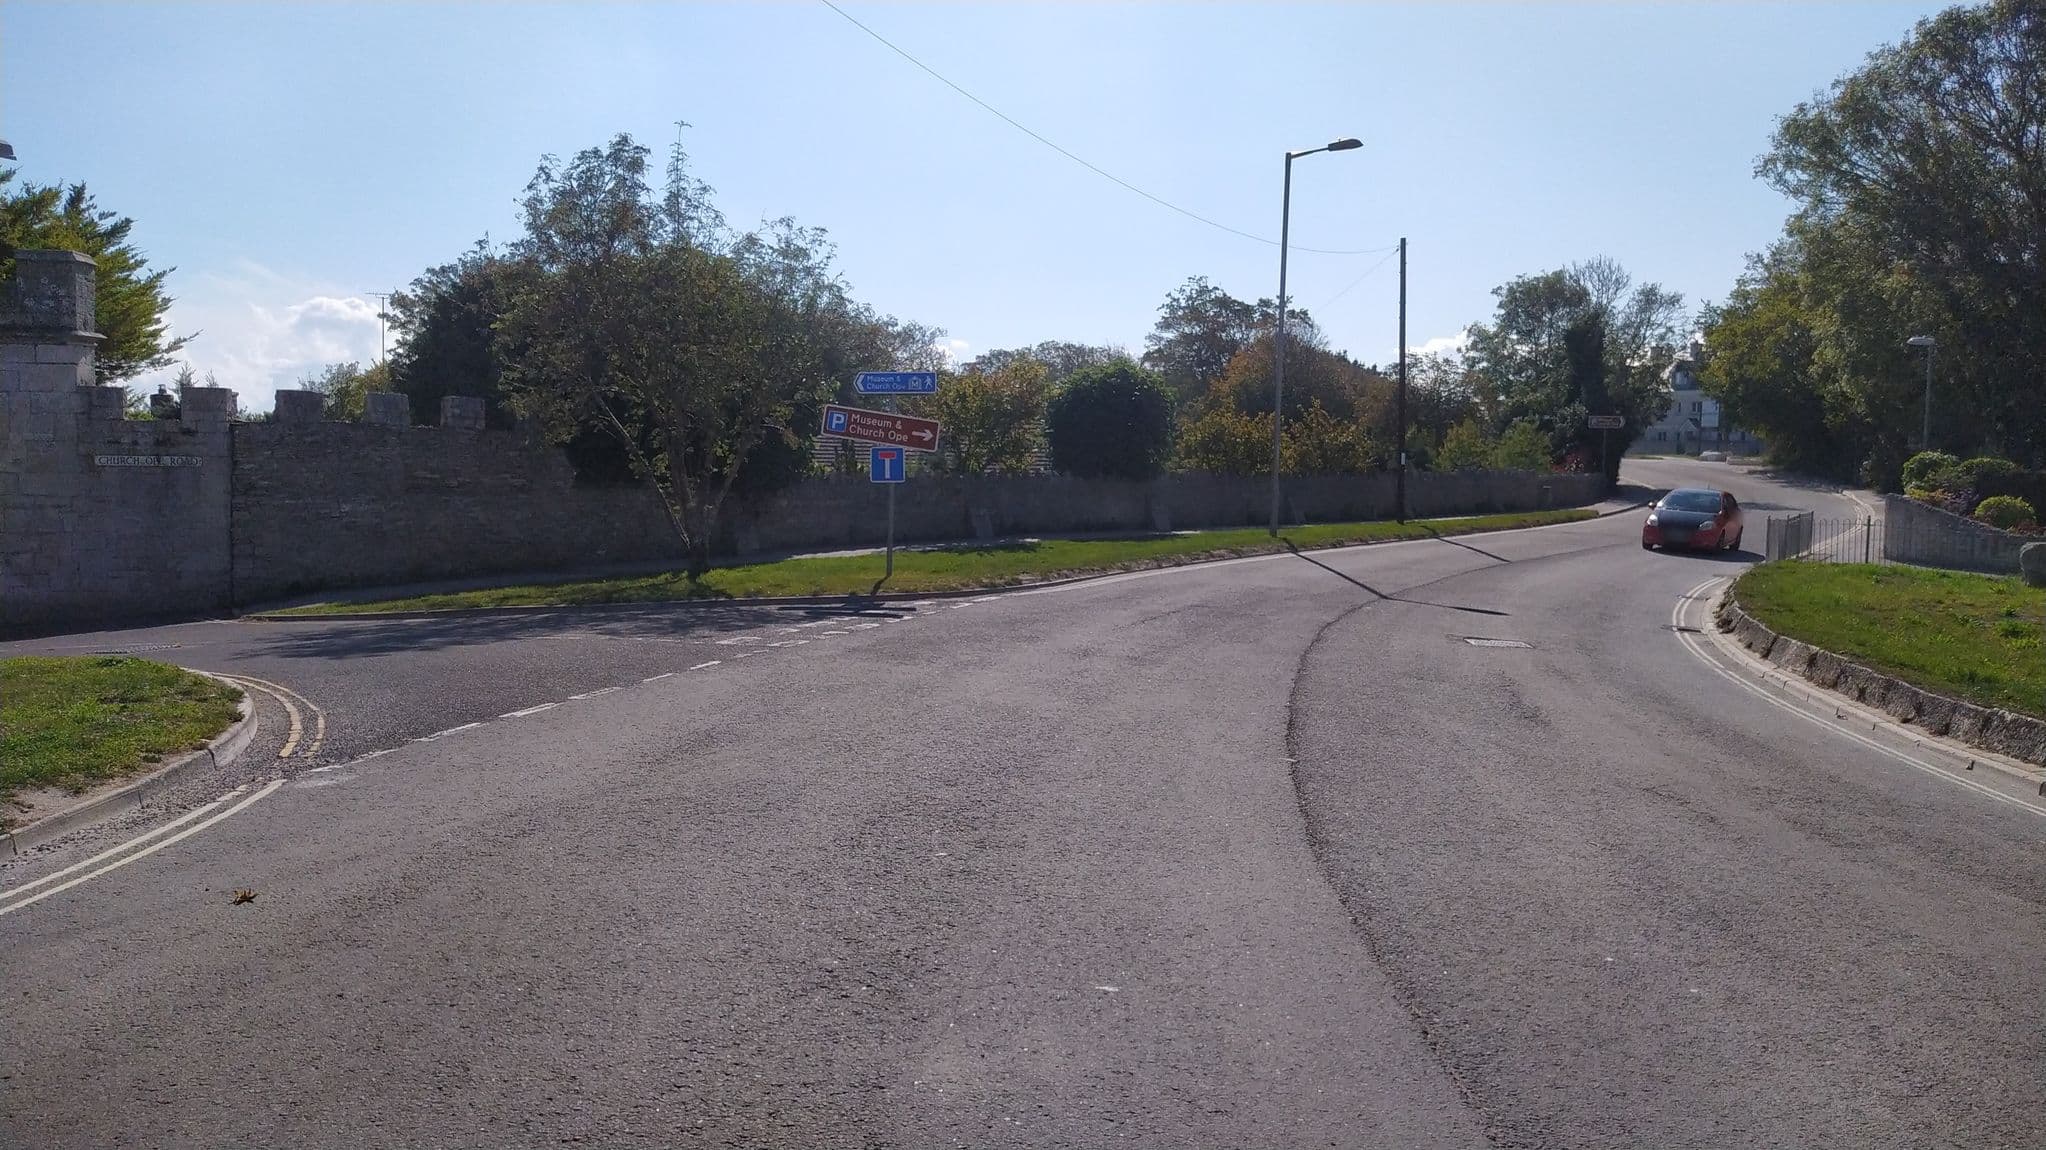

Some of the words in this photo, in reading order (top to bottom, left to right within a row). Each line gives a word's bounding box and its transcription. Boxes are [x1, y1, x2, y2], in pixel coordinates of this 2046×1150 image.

[832, 414, 844, 429] P
[851, 413, 892, 428] Museum
[895, 420, 902, 429] &
[849, 425, 884, 438] Church
[888, 431, 908, 443] Ope
[98, 456, 140, 465] CHURCH
